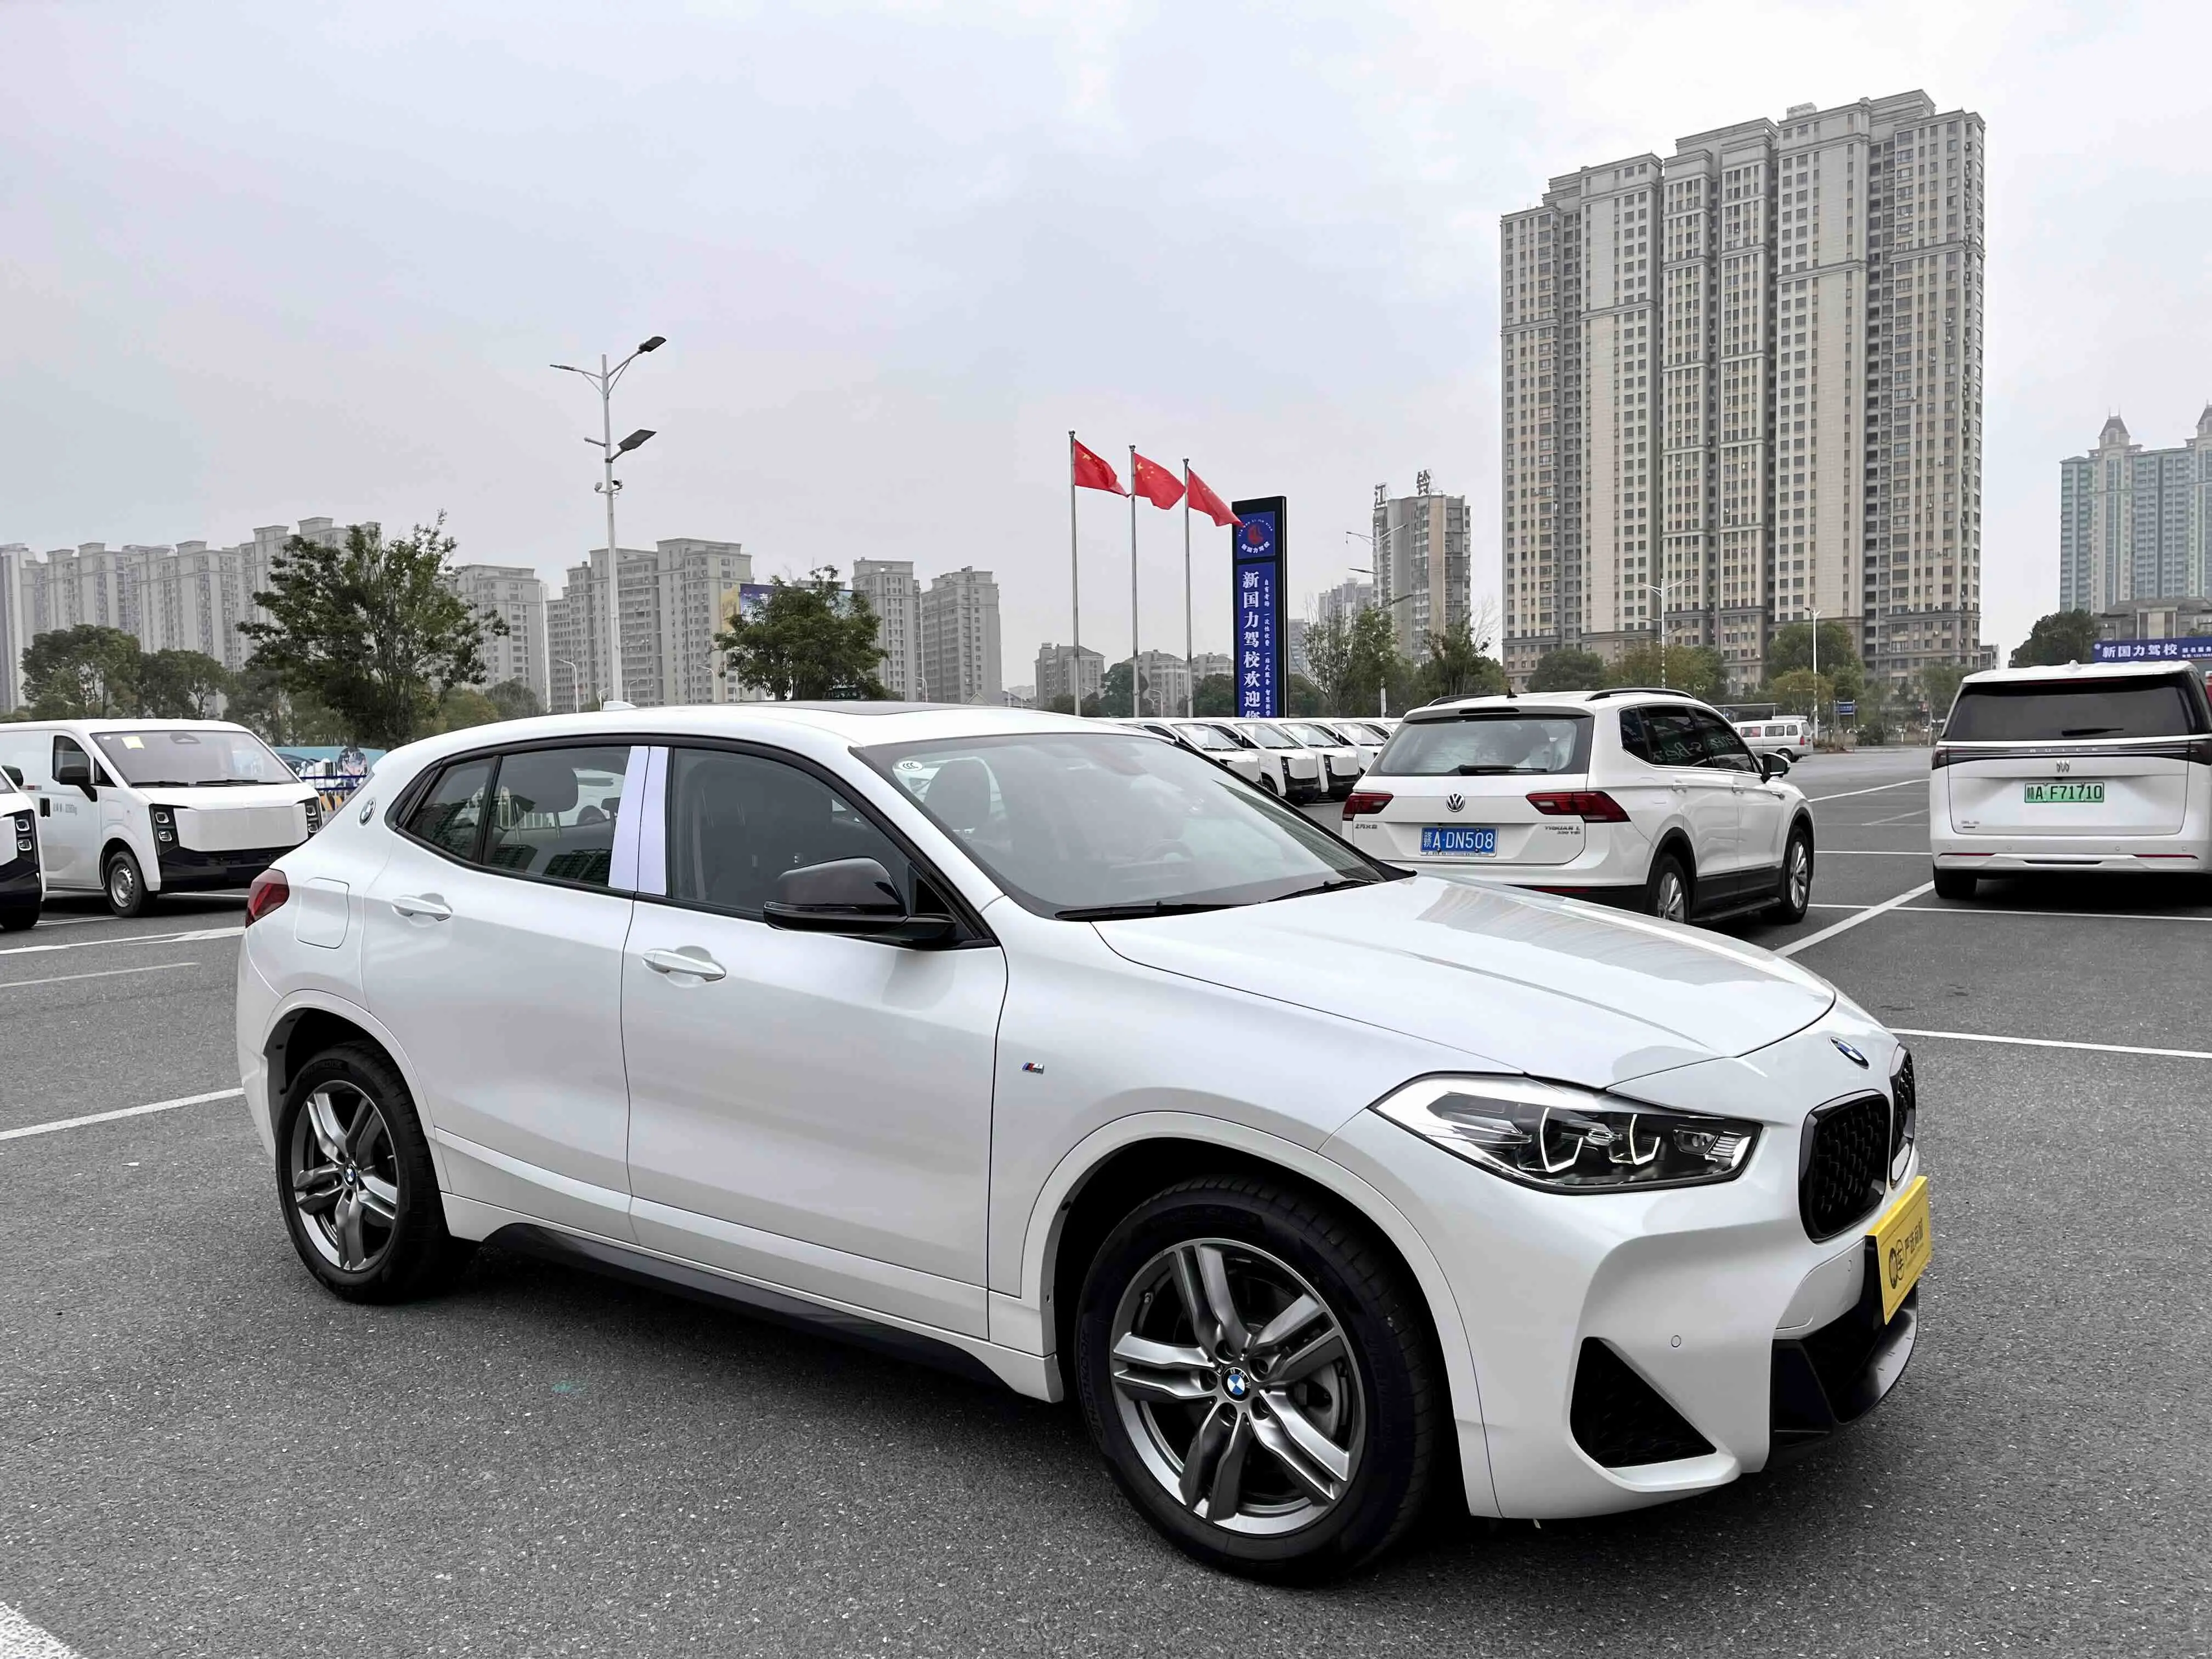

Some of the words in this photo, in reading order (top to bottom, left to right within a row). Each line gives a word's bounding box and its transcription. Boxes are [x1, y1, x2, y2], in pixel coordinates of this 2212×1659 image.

[2102, 644, 2177, 658] 新国力驾校
